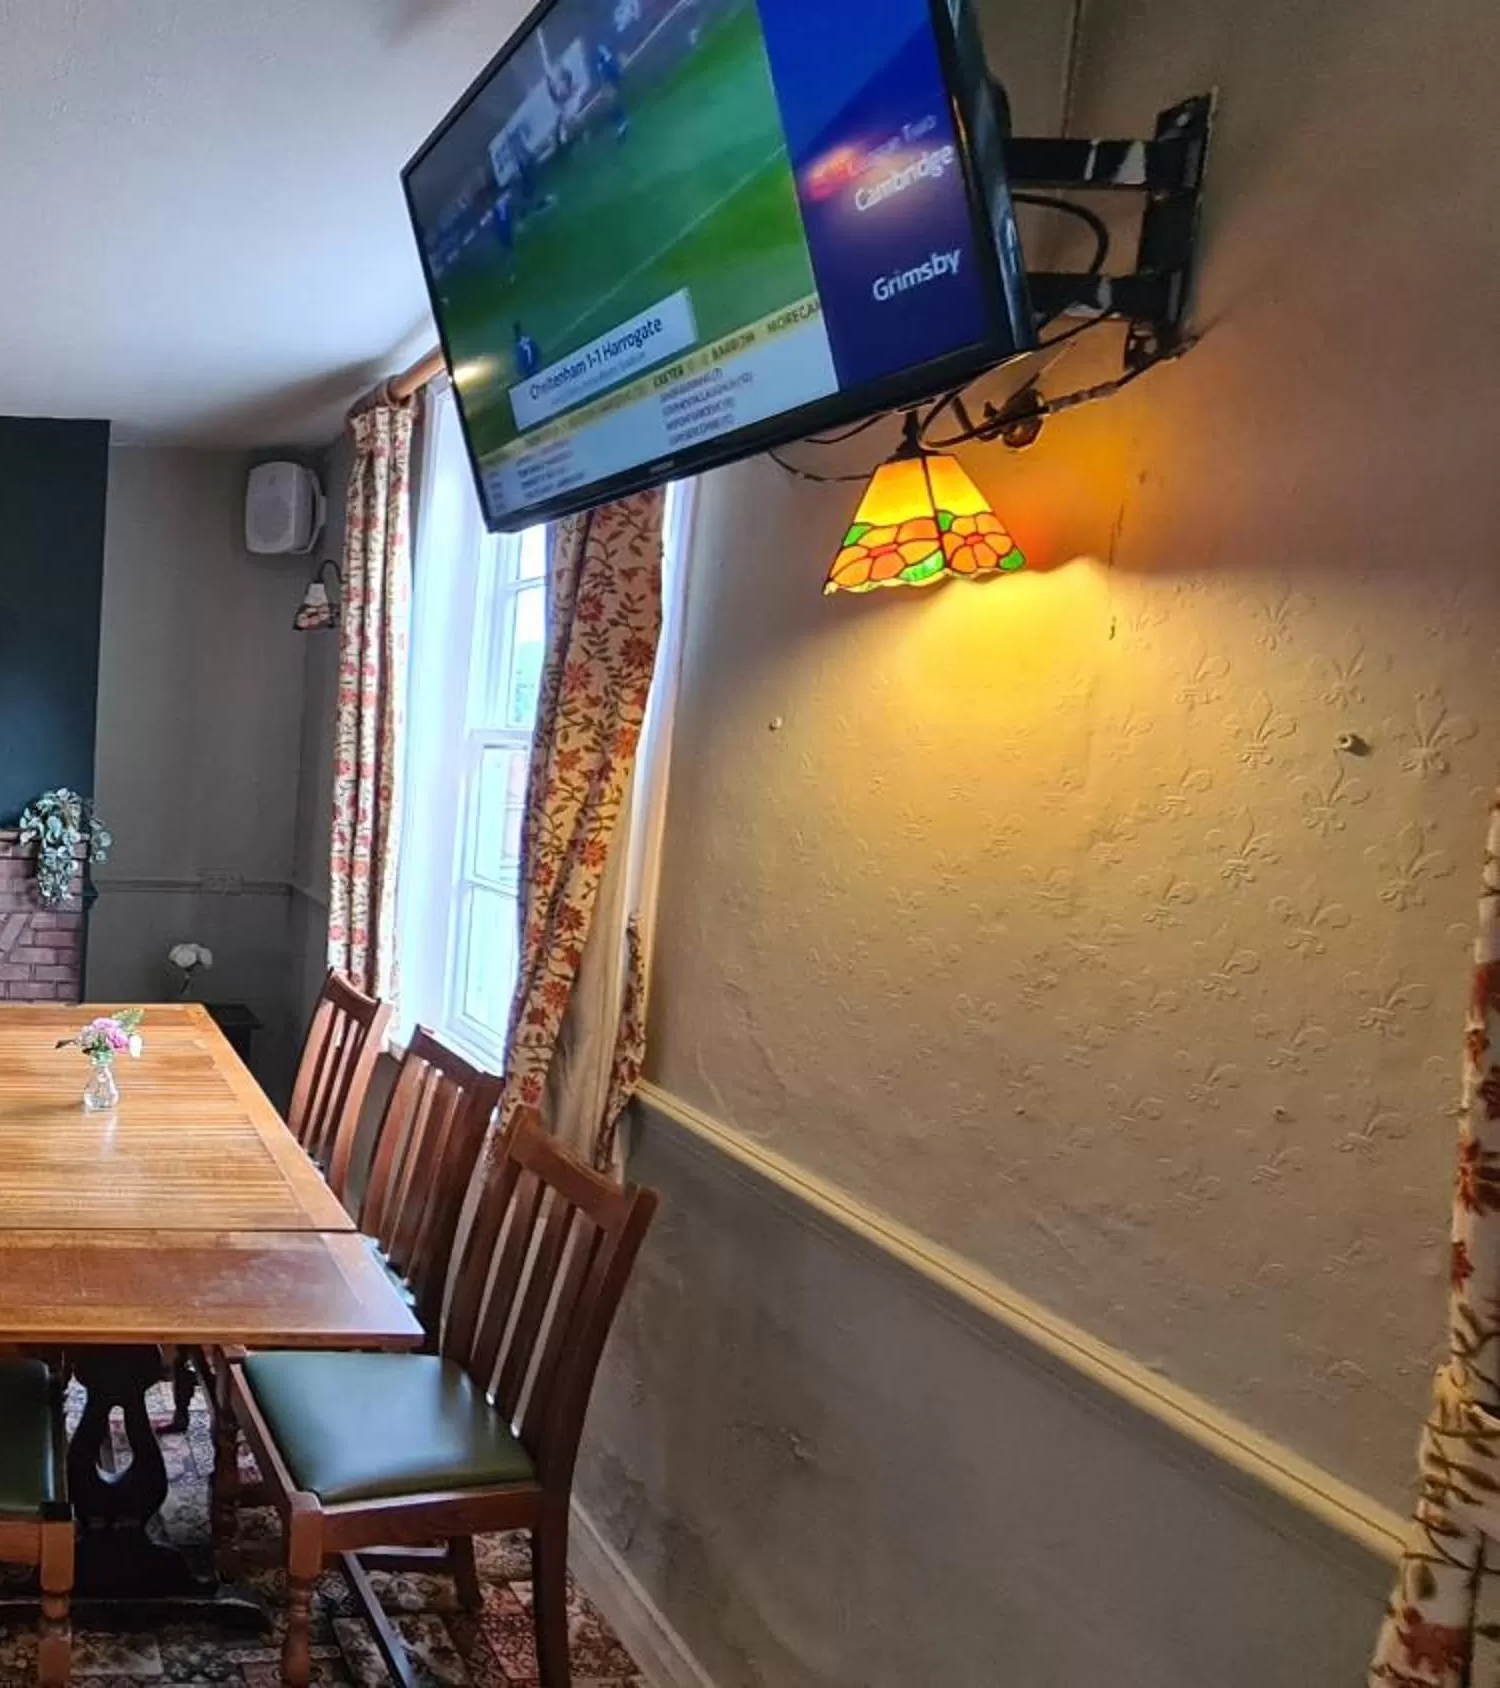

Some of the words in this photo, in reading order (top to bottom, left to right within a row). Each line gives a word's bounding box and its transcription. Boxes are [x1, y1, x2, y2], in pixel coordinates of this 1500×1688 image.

[855, 145, 954, 212] Cambridge
[872, 249, 961, 301] Grimsby
[601, 317, 663, 362] Harrogate
